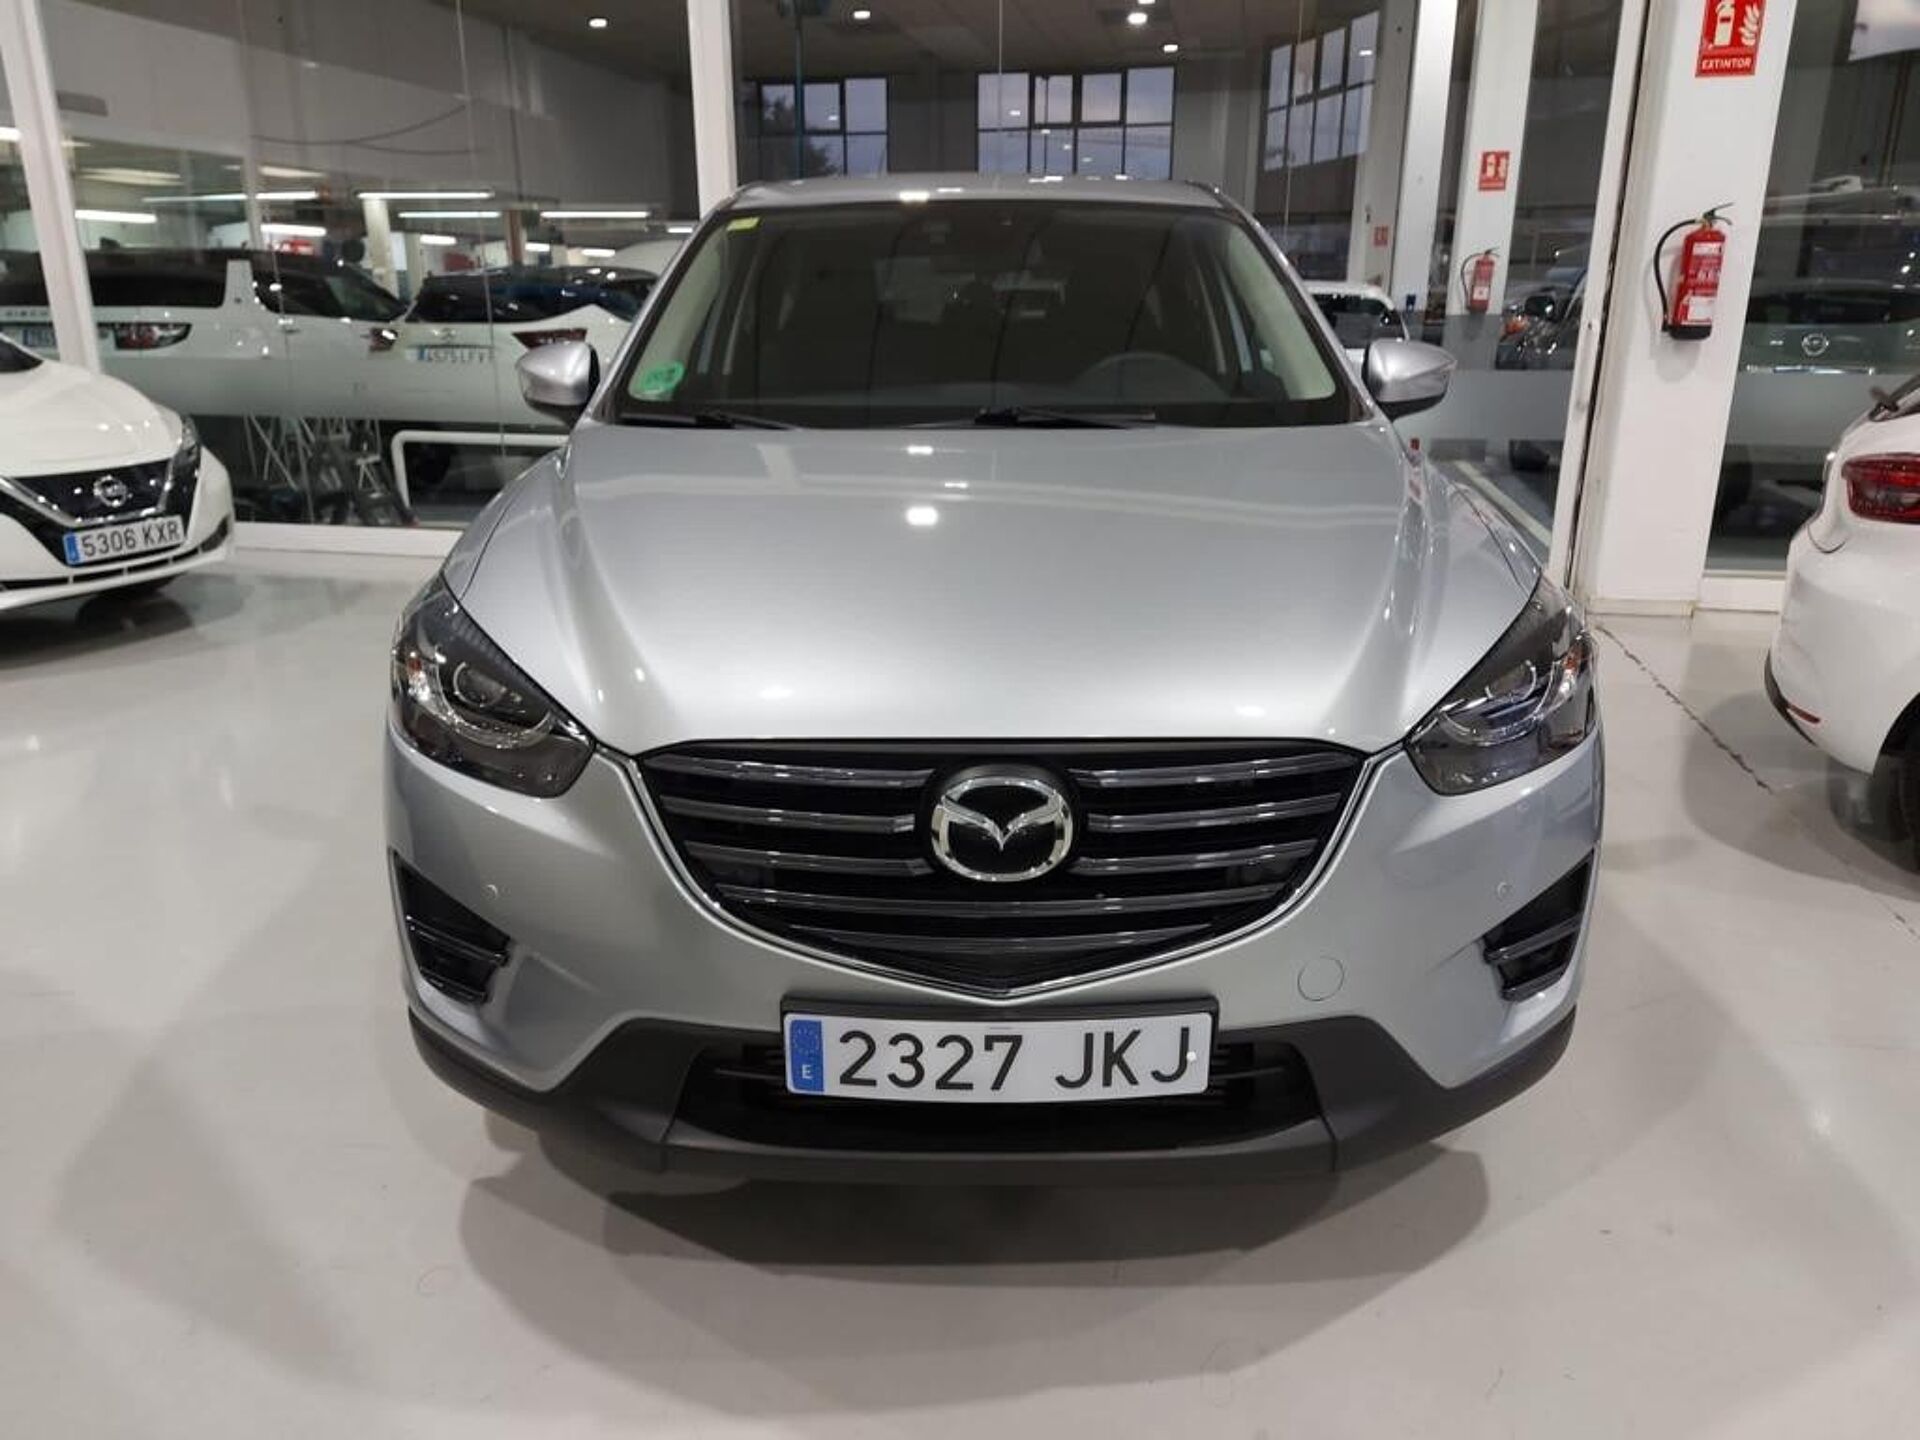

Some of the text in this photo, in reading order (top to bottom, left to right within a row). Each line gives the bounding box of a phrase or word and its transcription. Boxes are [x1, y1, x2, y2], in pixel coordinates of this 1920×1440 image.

[1702, 57, 1752, 70] EXTINTOR
[81, 520, 178, 557] 5306 KXR
[802, 1063, 813, 1079] E
[839, 1026, 1190, 1091] 2327 JKJ
